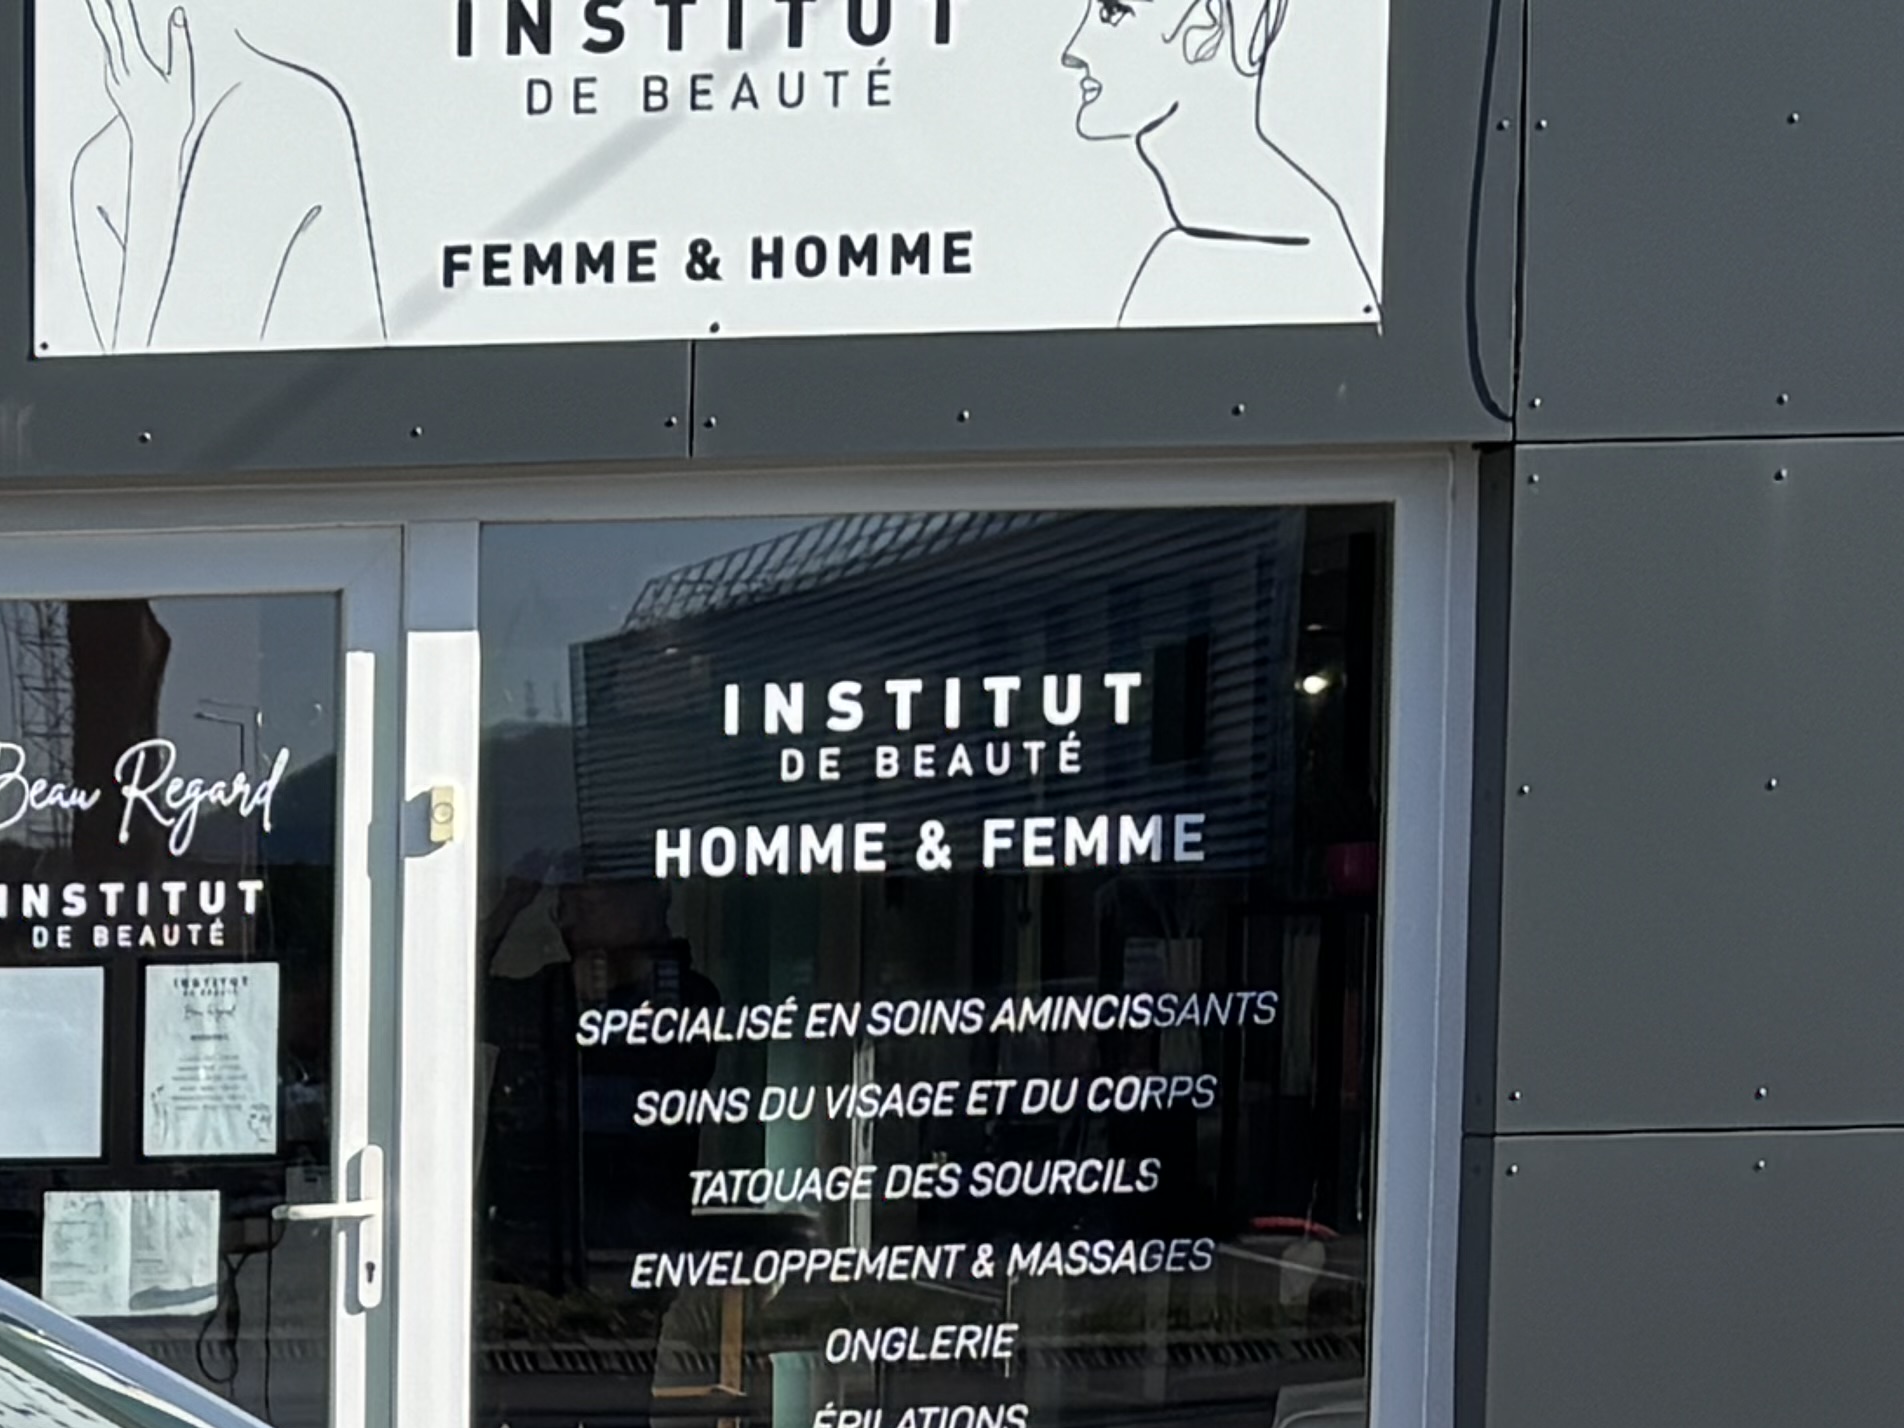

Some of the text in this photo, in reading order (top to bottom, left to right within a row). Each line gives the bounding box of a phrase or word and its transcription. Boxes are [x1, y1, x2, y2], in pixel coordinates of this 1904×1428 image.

[526, 57, 891, 116] DE BEAUTÉ
[442, 230, 973, 289] FEMME & HOMME
[724, 672, 1142, 736] INSTITUT
[780, 730, 1081, 782] DE BEAUTÉ
[112, 736, 292, 858] Regard
[655, 814, 1205, 879] HOMME & FEMME
[32, 918, 224, 949] DE BEAUTÉ
[572, 991, 1278, 1048] SPÉCIALISÉ EN SOINS AMINCISSANTS
[630, 1074, 1218, 1128] SOINS DU VISAGE ET DU CORPS
[688, 1157, 1162, 1208] TATOUAGE DES SOURCILS
[629, 1238, 1216, 1290] ENVELOPPEMENT & MASSAGES
[822, 1322, 1020, 1364] ONGLERIE
